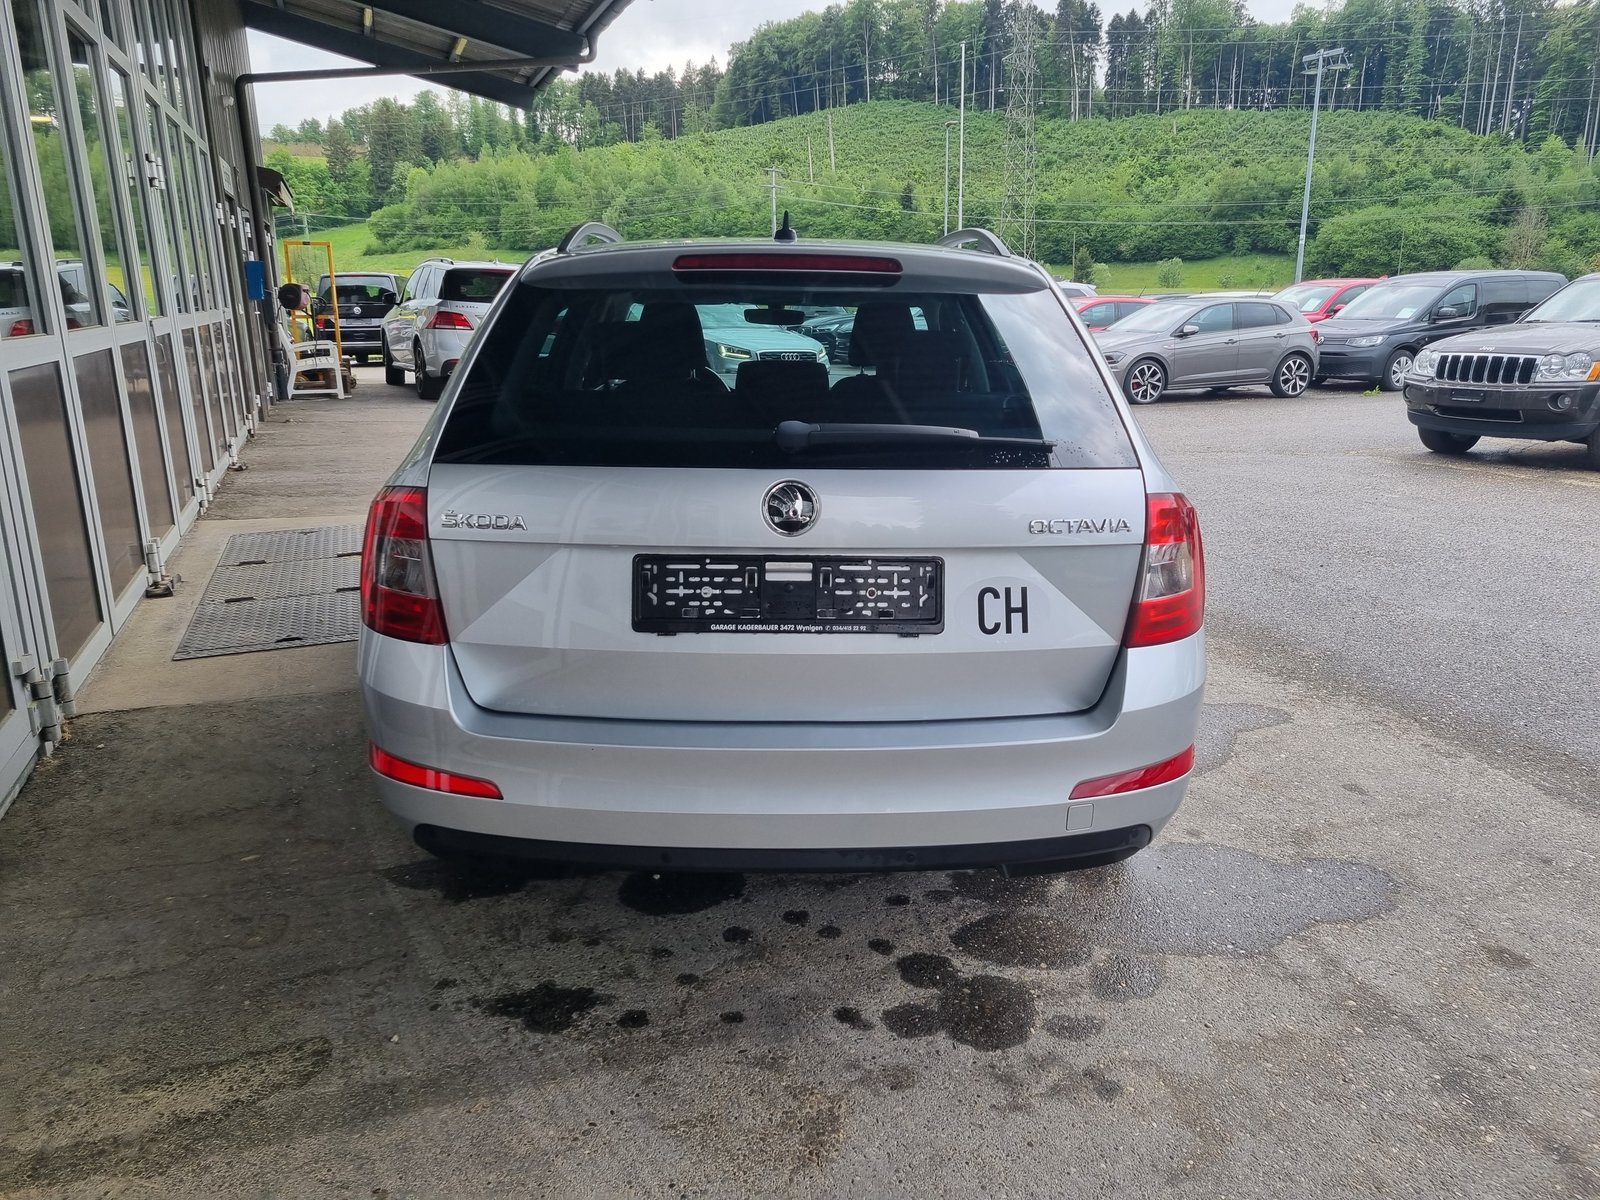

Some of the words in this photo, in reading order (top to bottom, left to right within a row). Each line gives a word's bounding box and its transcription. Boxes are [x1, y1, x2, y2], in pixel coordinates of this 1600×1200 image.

[441, 510, 528, 531] ŠKODA
[1029, 518, 1132, 535] OCTAVIA
[977, 586, 1029, 635] CH
[796, 624, 823, 632] Wynigen
